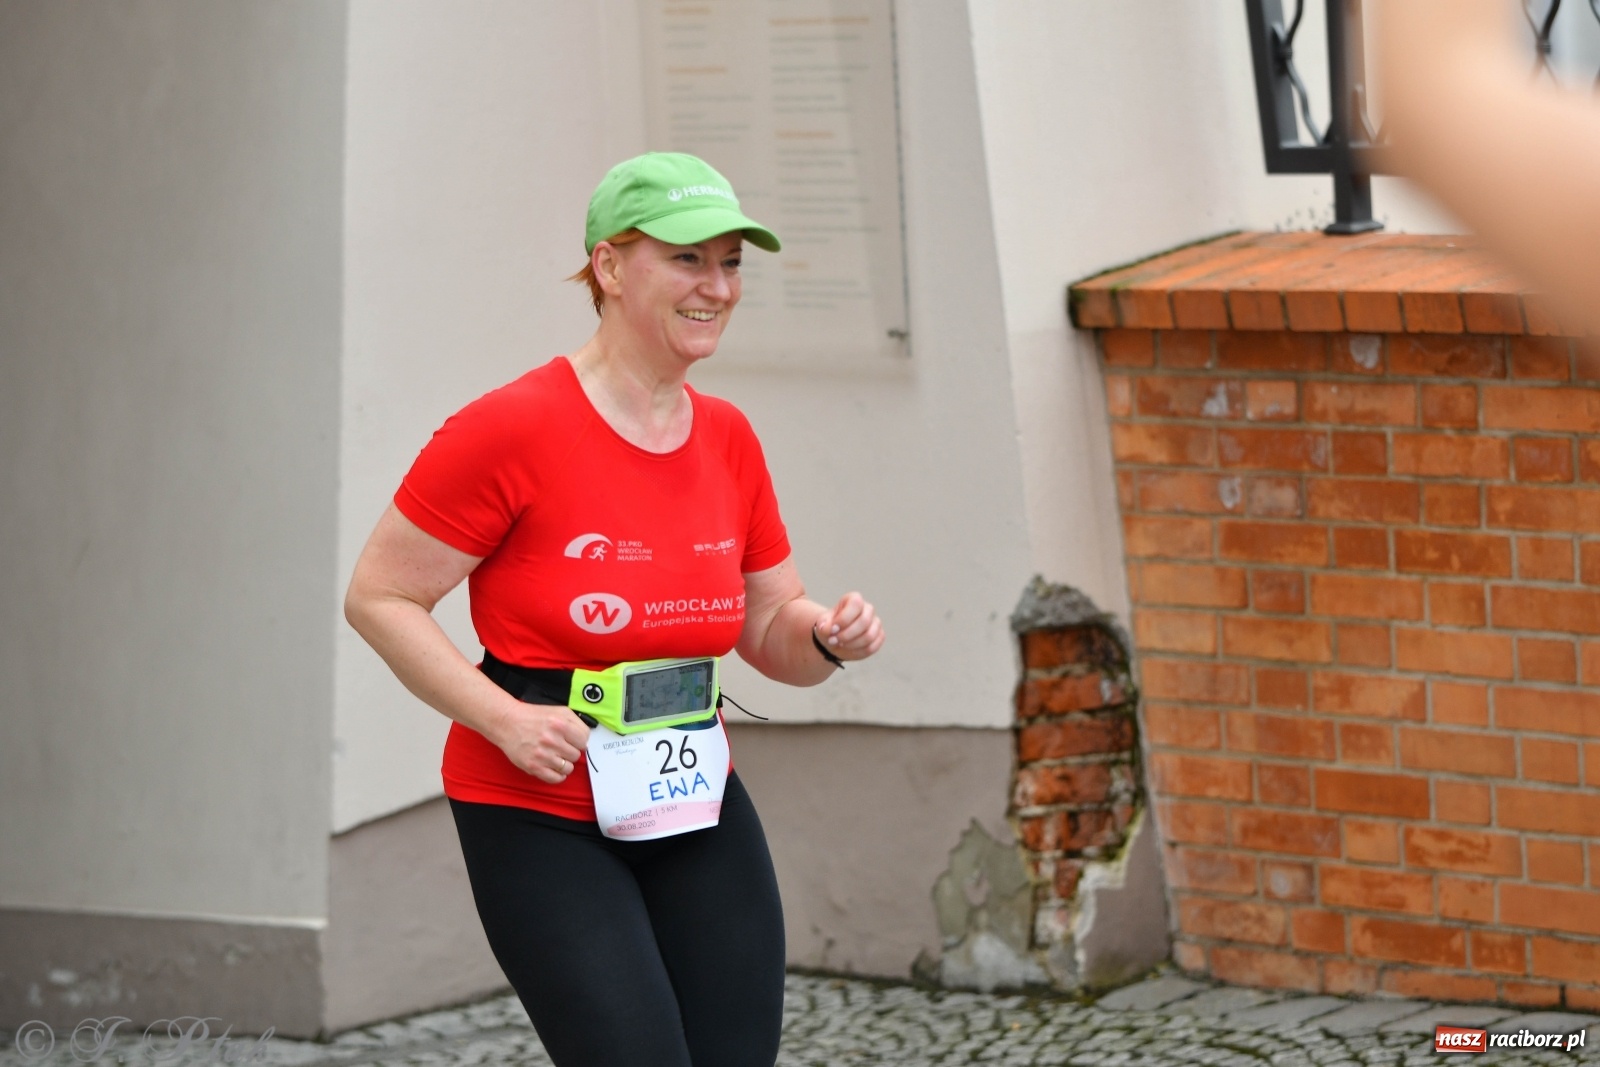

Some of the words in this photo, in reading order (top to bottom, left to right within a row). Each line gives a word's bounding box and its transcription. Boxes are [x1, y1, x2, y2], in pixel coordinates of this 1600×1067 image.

[644, 597, 734, 616] WROCŁAW
[642, 615, 704, 629] Europejska
[707, 614, 737, 624] Stolica
[655, 735, 698, 775] 26
[649, 771, 710, 802] EWA
[667, 804, 678, 813] KM
[617, 819, 656, 832] 30.08.2020
